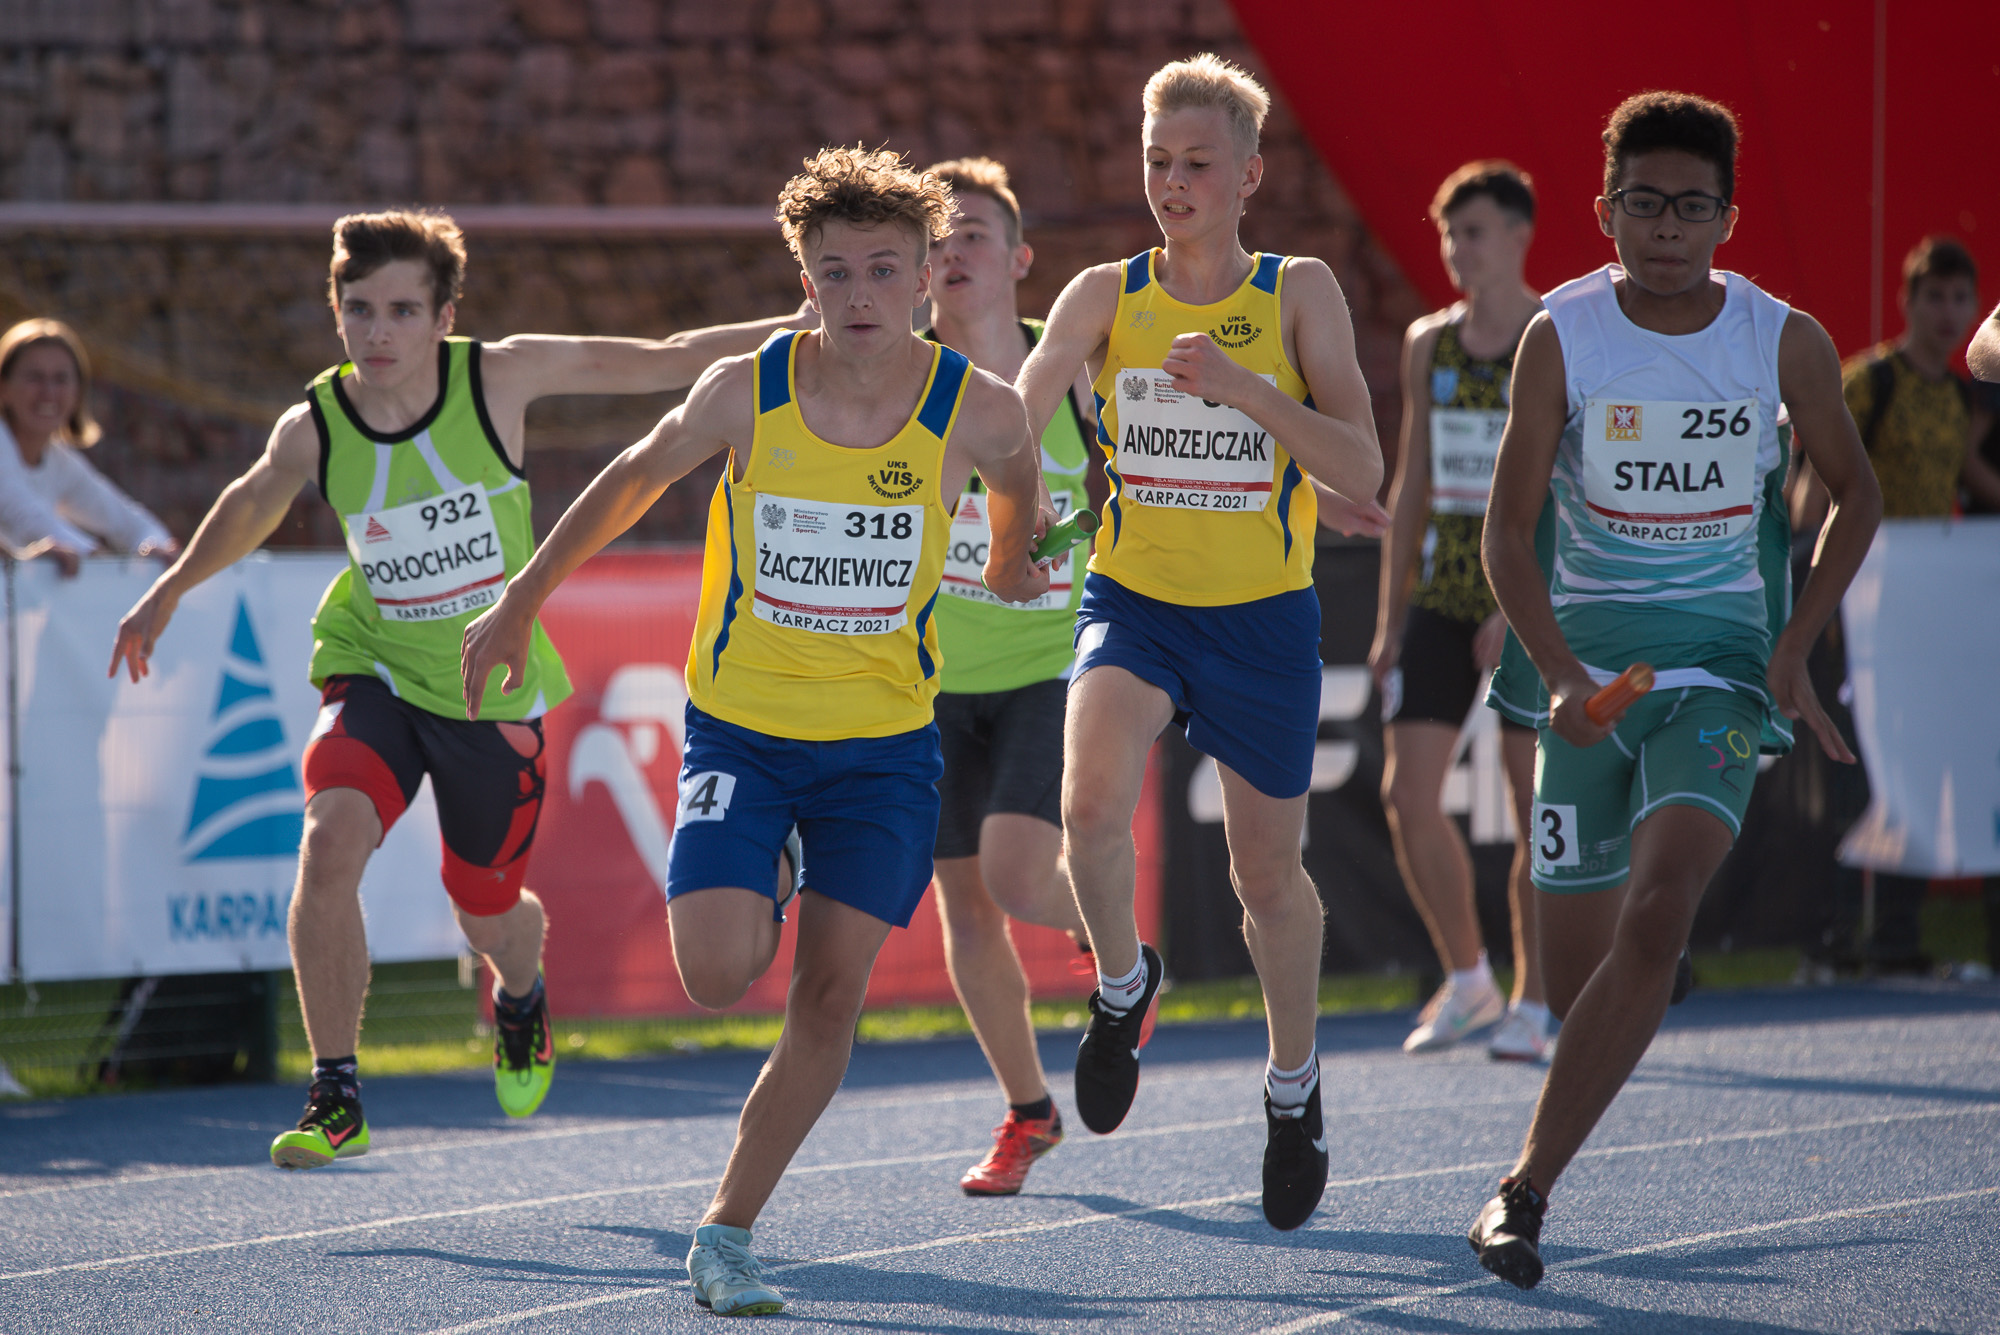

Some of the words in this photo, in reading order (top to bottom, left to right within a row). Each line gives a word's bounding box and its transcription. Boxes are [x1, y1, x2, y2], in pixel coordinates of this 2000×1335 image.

[1220, 322, 1252, 336] VIS
[1228, 315, 1247, 323] UKS
[1209, 327, 1262, 348] SKIERNIEWICE
[1608, 429, 1641, 440] PZLA
[1680, 405, 1751, 439] 256
[1123, 424, 1267, 462] ANDRZEJCZAK
[879, 470, 913, 487] VIS
[887, 460, 908, 470] UKS
[1614, 461, 1725, 492] STALA
[867, 474, 924, 500] SKIERNIEWICE
[1136, 489, 1208, 507] KARPACZ
[1213, 495, 1248, 509] 2021
[421, 492, 481, 530] 932
[844, 511, 913, 540] 318
[1607, 521, 1687, 541] KARPACZ
[1691, 522, 1728, 539] 2021
[362, 532, 498, 585] POŁOCHACZ
[759, 542, 913, 588] ŻACZKIEWICZ
[395, 601, 460, 620] KARPACZ
[464, 589, 496, 609] 2021
[772, 610, 849, 633] KARPACZ
[853, 619, 890, 633] 2021
[687, 775, 719, 816] 4
[1541, 809, 1566, 862] 3
[166, 891, 292, 942] KARPA
